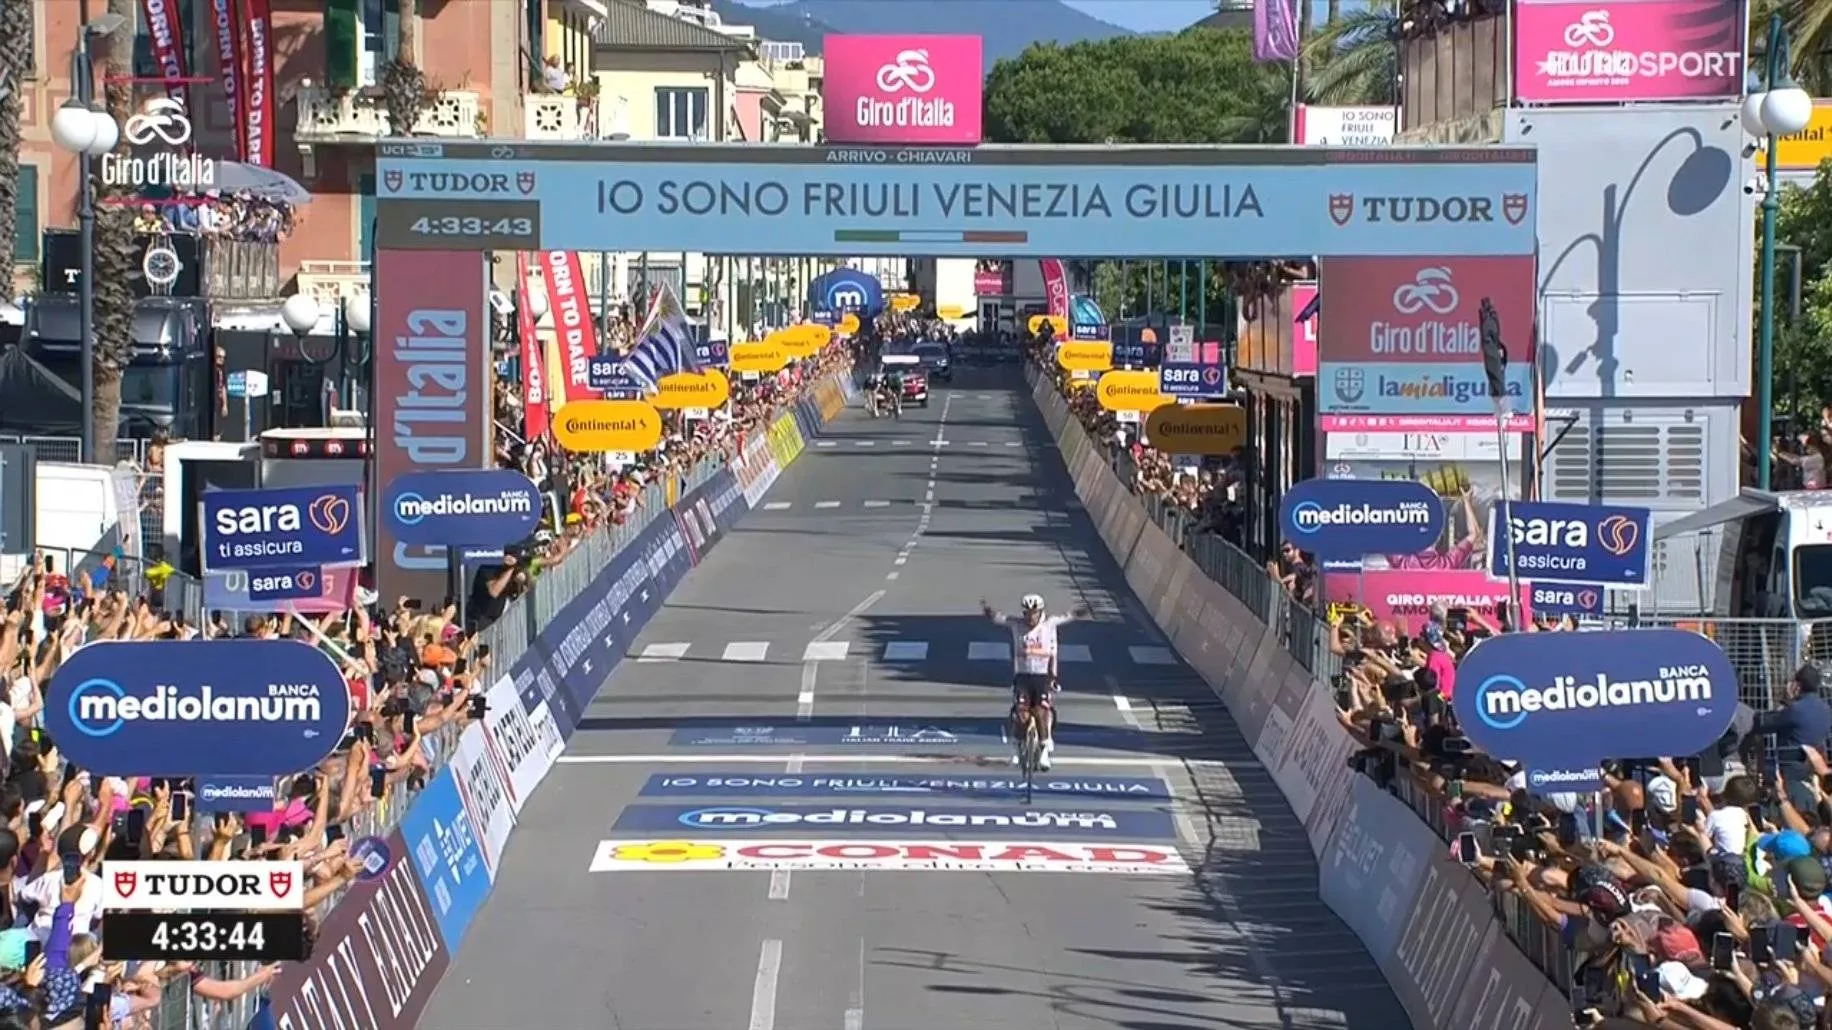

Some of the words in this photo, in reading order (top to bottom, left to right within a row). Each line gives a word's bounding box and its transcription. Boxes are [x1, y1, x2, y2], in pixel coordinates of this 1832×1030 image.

[148, 0, 173, 47] ORN
[857, 96, 893, 126] Giro
[895, 96, 954, 127] d'Italia
[1342, 111, 1356, 121] IO
[1359, 111, 1394, 121] SONO
[827, 151, 887, 163] ARRIVO
[897, 151, 972, 163] CHIAVARI
[410, 171, 509, 193] TUDOR
[598, 180, 643, 215] IO
[658, 180, 789, 216] SONO
[803, 182, 919, 217] FRIULI
[933, 182, 1112, 218] VENEZIA
[1125, 182, 1265, 218] GIULIA
[1363, 196, 1494, 222] TUDOR
[410, 216, 533, 236] 4:33:43
[550, 250, 575, 296] ORN
[560, 296, 581, 328] TO
[1370, 320, 1412, 354] Giro
[1415, 320, 1481, 354] d'Italia
[696, 346, 711, 357] ra
[1163, 368, 1200, 382] sara
[393, 309, 467, 464] d'Italia
[1106, 385, 1158, 397] Continenta
[1378, 374, 1523, 403] lamialigua
[566, 418, 636, 434] Continental
[1159, 421, 1230, 437] Continental
[501, 490, 529, 499] BANCA
[400, 493, 531, 516] mediolanum
[1400, 502, 1428, 510] BANCA
[216, 503, 301, 536] sara
[1299, 503, 1429, 526] mediolanum
[1510, 516, 1588, 547] sara
[219, 543, 231, 558] ti
[234, 540, 303, 557] assicura
[1518, 554, 1587, 570] assicura
[252, 575, 292, 591] sara
[1386, 593, 1425, 605] GIRO
[1534, 588, 1574, 605] sara
[1659, 665, 1709, 679] BANCA
[268, 684, 320, 697] BANCA
[1486, 674, 1712, 714] mediolanum
[80, 685, 320, 721] mediolanum
[662, 777, 698, 788] IO
[706, 777, 804, 788] SONO
[812, 778, 899, 789] FRIULI
[907, 779, 1041, 791] VENEZIA
[1047, 780, 1151, 792] GIULIA
[1532, 770, 1600, 783] mediolanum
[203, 785, 274, 799] mediolanum
[699, 810, 1118, 829] mediolanum
[736, 844, 1169, 864] CONAD
[358, 856, 438, 1020] EATALY
